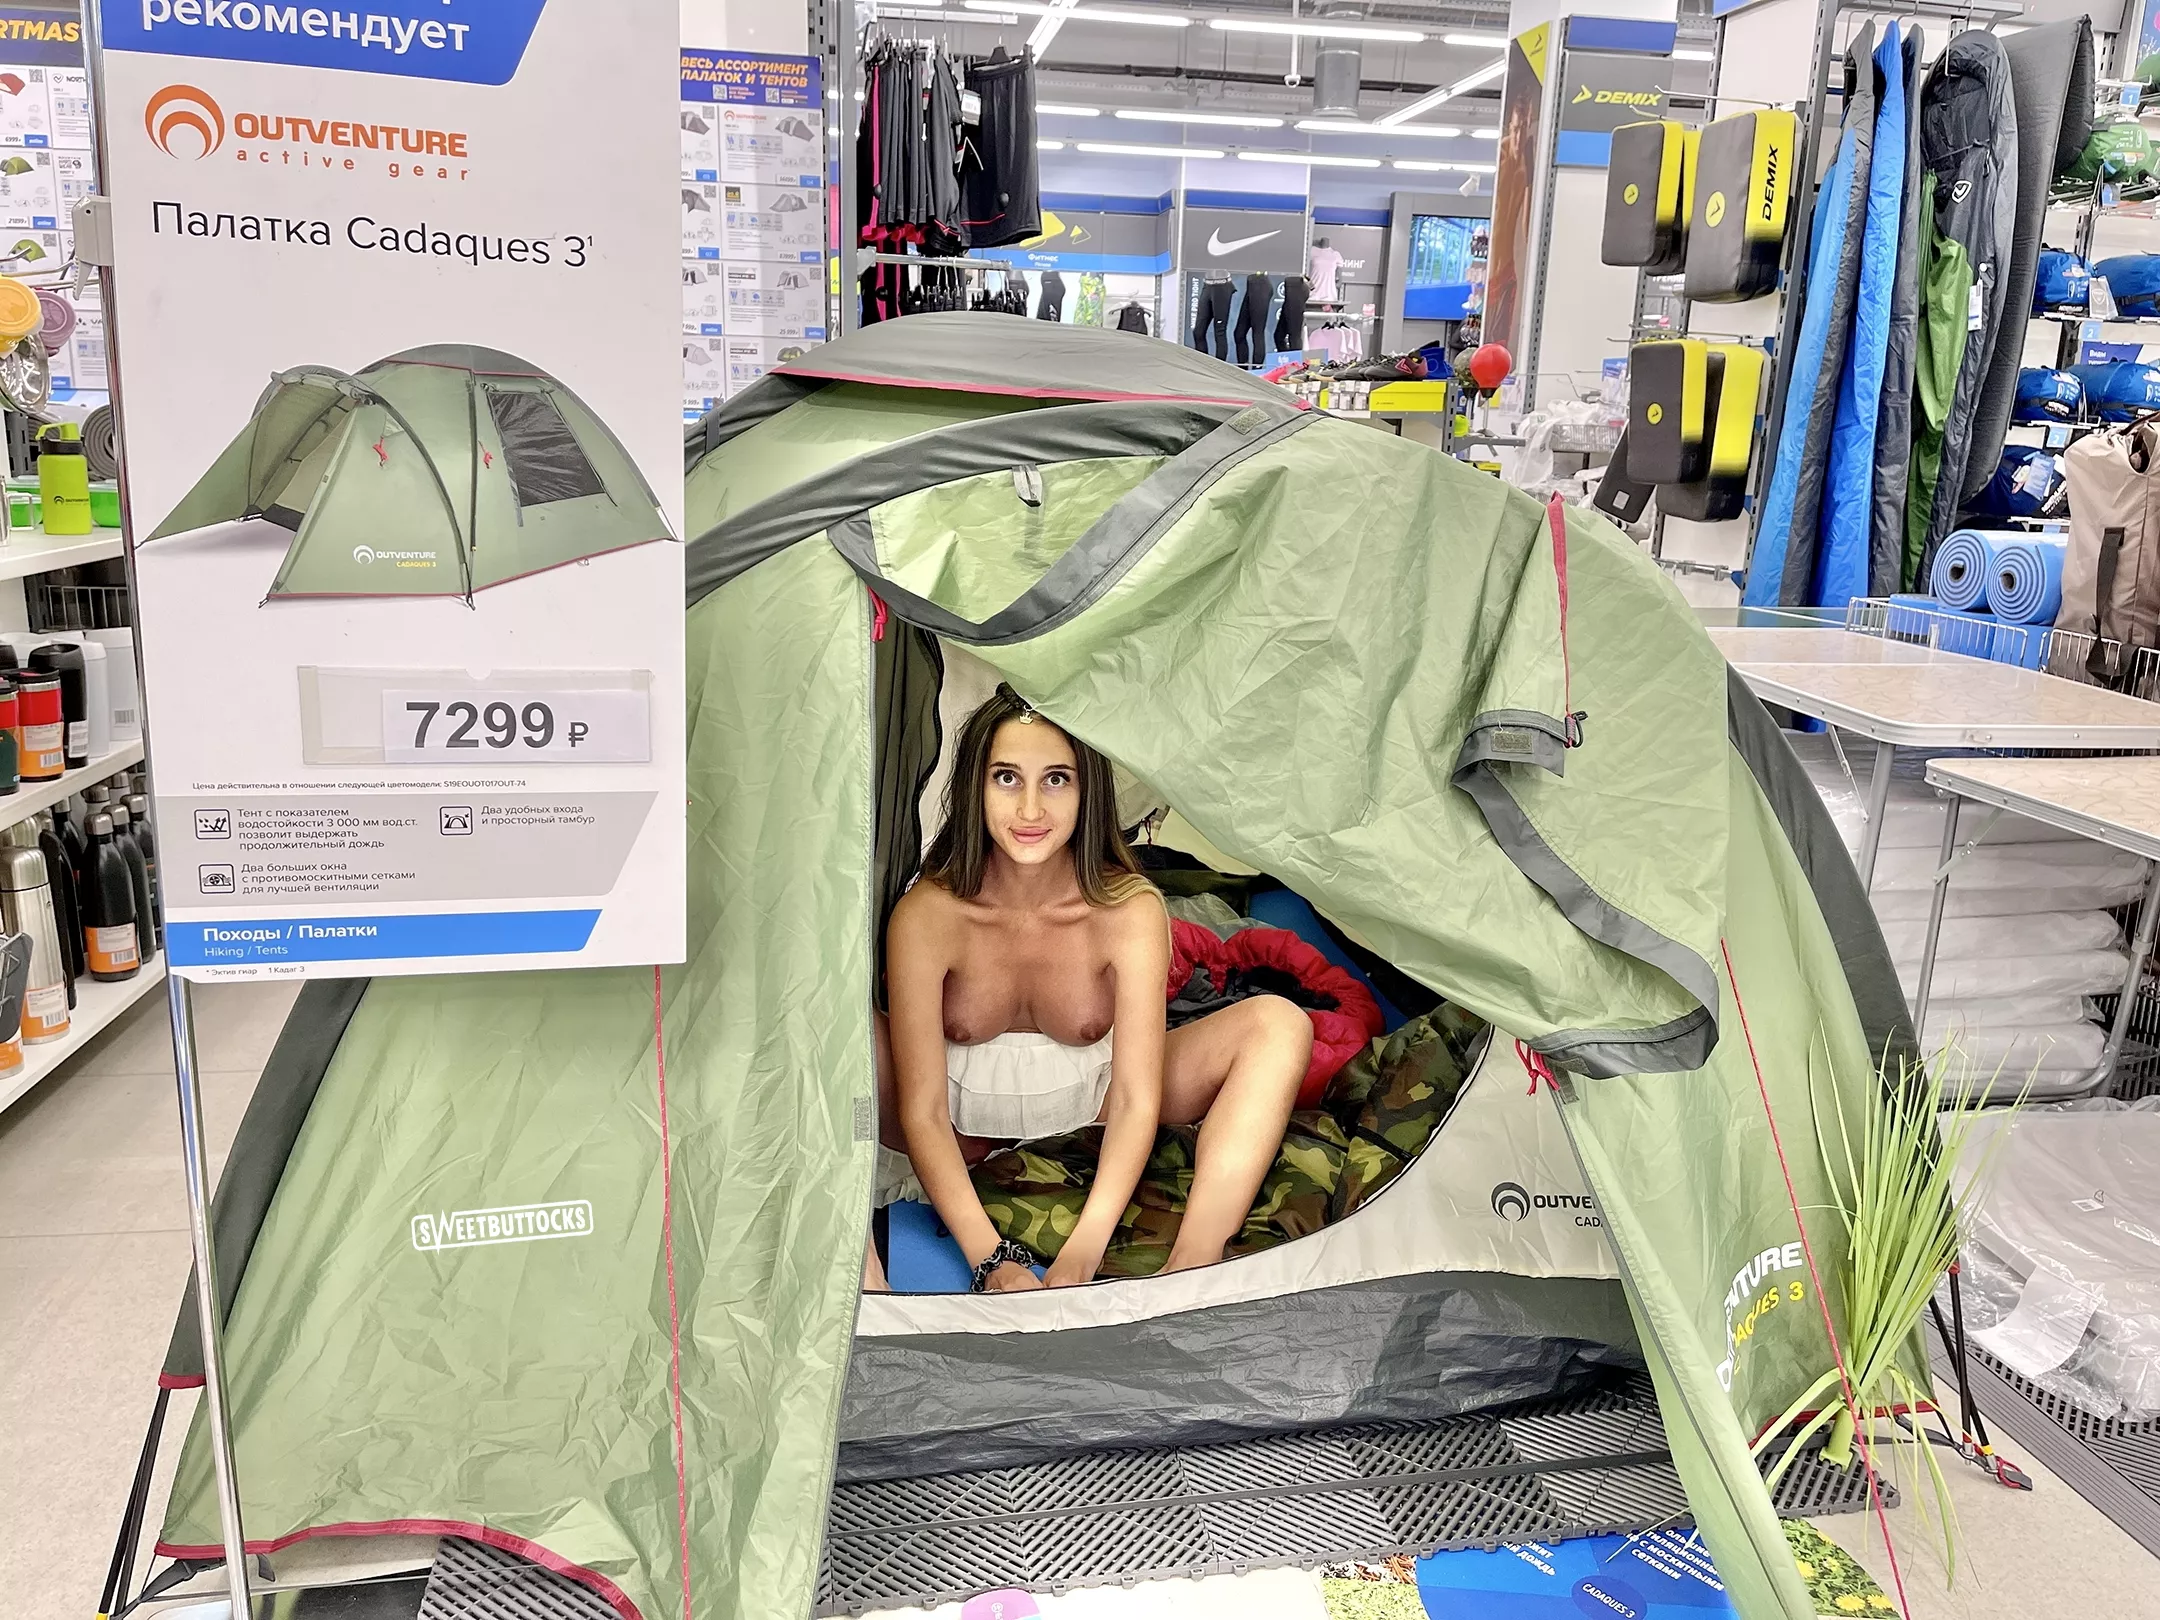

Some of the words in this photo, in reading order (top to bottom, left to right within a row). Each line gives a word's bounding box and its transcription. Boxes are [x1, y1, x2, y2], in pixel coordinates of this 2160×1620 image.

[143, 0, 470, 54] рекомендует
[681, 57, 713, 69] ВЕСЬ
[715, 59, 808, 75] АССОРТИМЕНТ
[681, 69, 742, 83] ПАЛАТОК
[745, 73, 756, 84] И
[760, 75, 808, 88] ТЕНТОВ
[1594, 90, 1662, 107] DEMIX
[234, 113, 468, 158] OUTVENTURE
[236, 149, 354, 170] active
[388, 162, 469, 181] gear
[1762, 143, 1779, 221] DEMIX
[152, 201, 331, 246] Палатка
[346, 216, 550, 266] Cadaques
[376, 551, 436, 559] OUTVENTURE
[405, 701, 554, 748] 7299
[192, 782, 215, 790] Цена
[217, 782, 280, 790] действительна
[338, 781, 385, 789] следующей
[237, 808, 262, 817] Тент
[275, 808, 349, 817] показателем
[481, 805, 502, 814] Два
[505, 805, 550, 815] удобных
[553, 806, 583, 814] входа
[238, 819, 323, 829] водостойкости
[326, 819, 333, 827] 3
[337, 818, 360, 827] 000
[382, 818, 418, 827] вод.ст.
[491, 816, 555, 825] просторный
[558, 815, 595, 824] тамбур
[239, 831, 291, 839] позволит
[295, 830, 358, 839] выдержать
[239, 840, 345, 850] продолжительный
[348, 840, 384, 848] дождь
[241, 863, 263, 873] Два
[267, 863, 317, 872] больших
[320, 863, 347, 871] окна
[242, 875, 248, 883] с
[251, 873, 368, 884] противомоскитными
[371, 871, 416, 880] сетками
[242, 886, 263, 894] для
[267, 884, 310, 894] лучшей
[314, 883, 379, 893] вентиляции
[203, 927, 281, 943] Походы
[298, 925, 377, 939] Палатки
[204, 946, 244, 958] Hiking
[255, 944, 288, 955] Tents
[274, 966, 297, 974] Кадаг
[1533, 1194, 1596, 1209] OUTVE
[1574, 1216, 1603, 1228] CAD
[1789, 1281, 1804, 1301] 3
[1516, 1550, 1556, 1576] дождь
[1631, 1548, 1682, 1580] сетками
[1647, 1544, 1725, 1591] москитными
[1582, 1583, 1628, 1614] CADAQUES
[1625, 1610, 1636, 1619] 3
